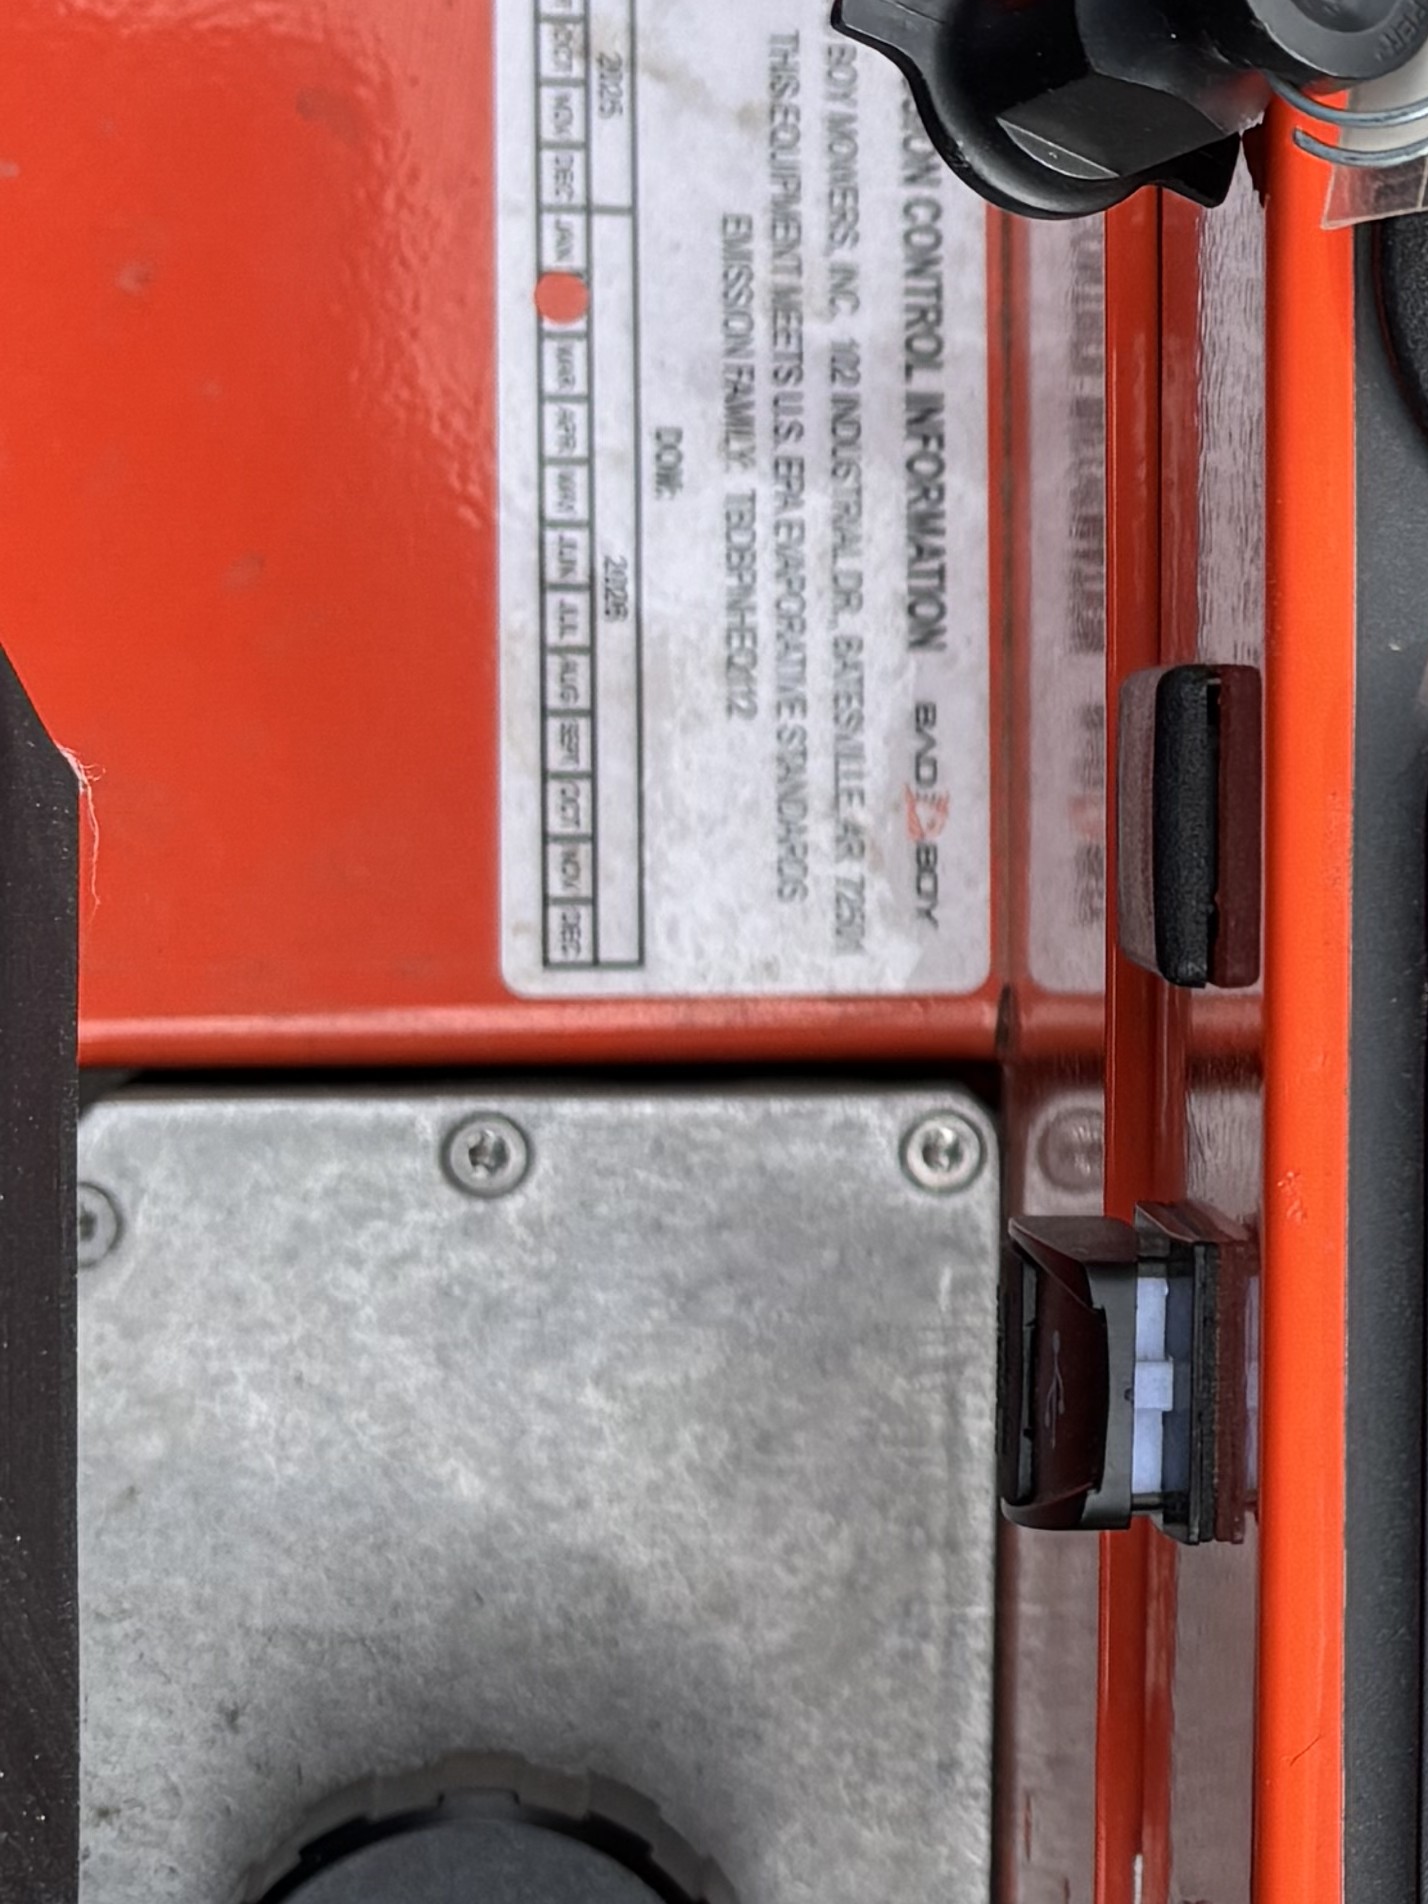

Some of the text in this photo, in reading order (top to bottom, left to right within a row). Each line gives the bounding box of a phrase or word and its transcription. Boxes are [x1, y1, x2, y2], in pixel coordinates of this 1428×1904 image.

[552, 23, 574, 74] OCT
[825, 46, 858, 107] BOY
[552, 154, 574, 202] DEC
[553, 219, 574, 264] JAN
[720, 212, 755, 359] EMISSION
[901, 197, 943, 383] CONTROL
[554, 406, 576, 454] APR
[767, 29, 808, 903] THIS EQUIPMENT MEETS U.S. EPA EVAPORATIVE STANDARDS
[829, 392, 862, 564] INDUSTRIAL
[903, 392, 947, 653] INFORMATION
[557, 534, 578, 580] JUN
[557, 598, 578, 640] JUL
[558, 655, 579, 704] AUG
[559, 781, 580, 832] OCT
[913, 701, 939, 928] BAD BOY
[832, 820, 866, 864] AR
[559, 909, 581, 958] DEC
